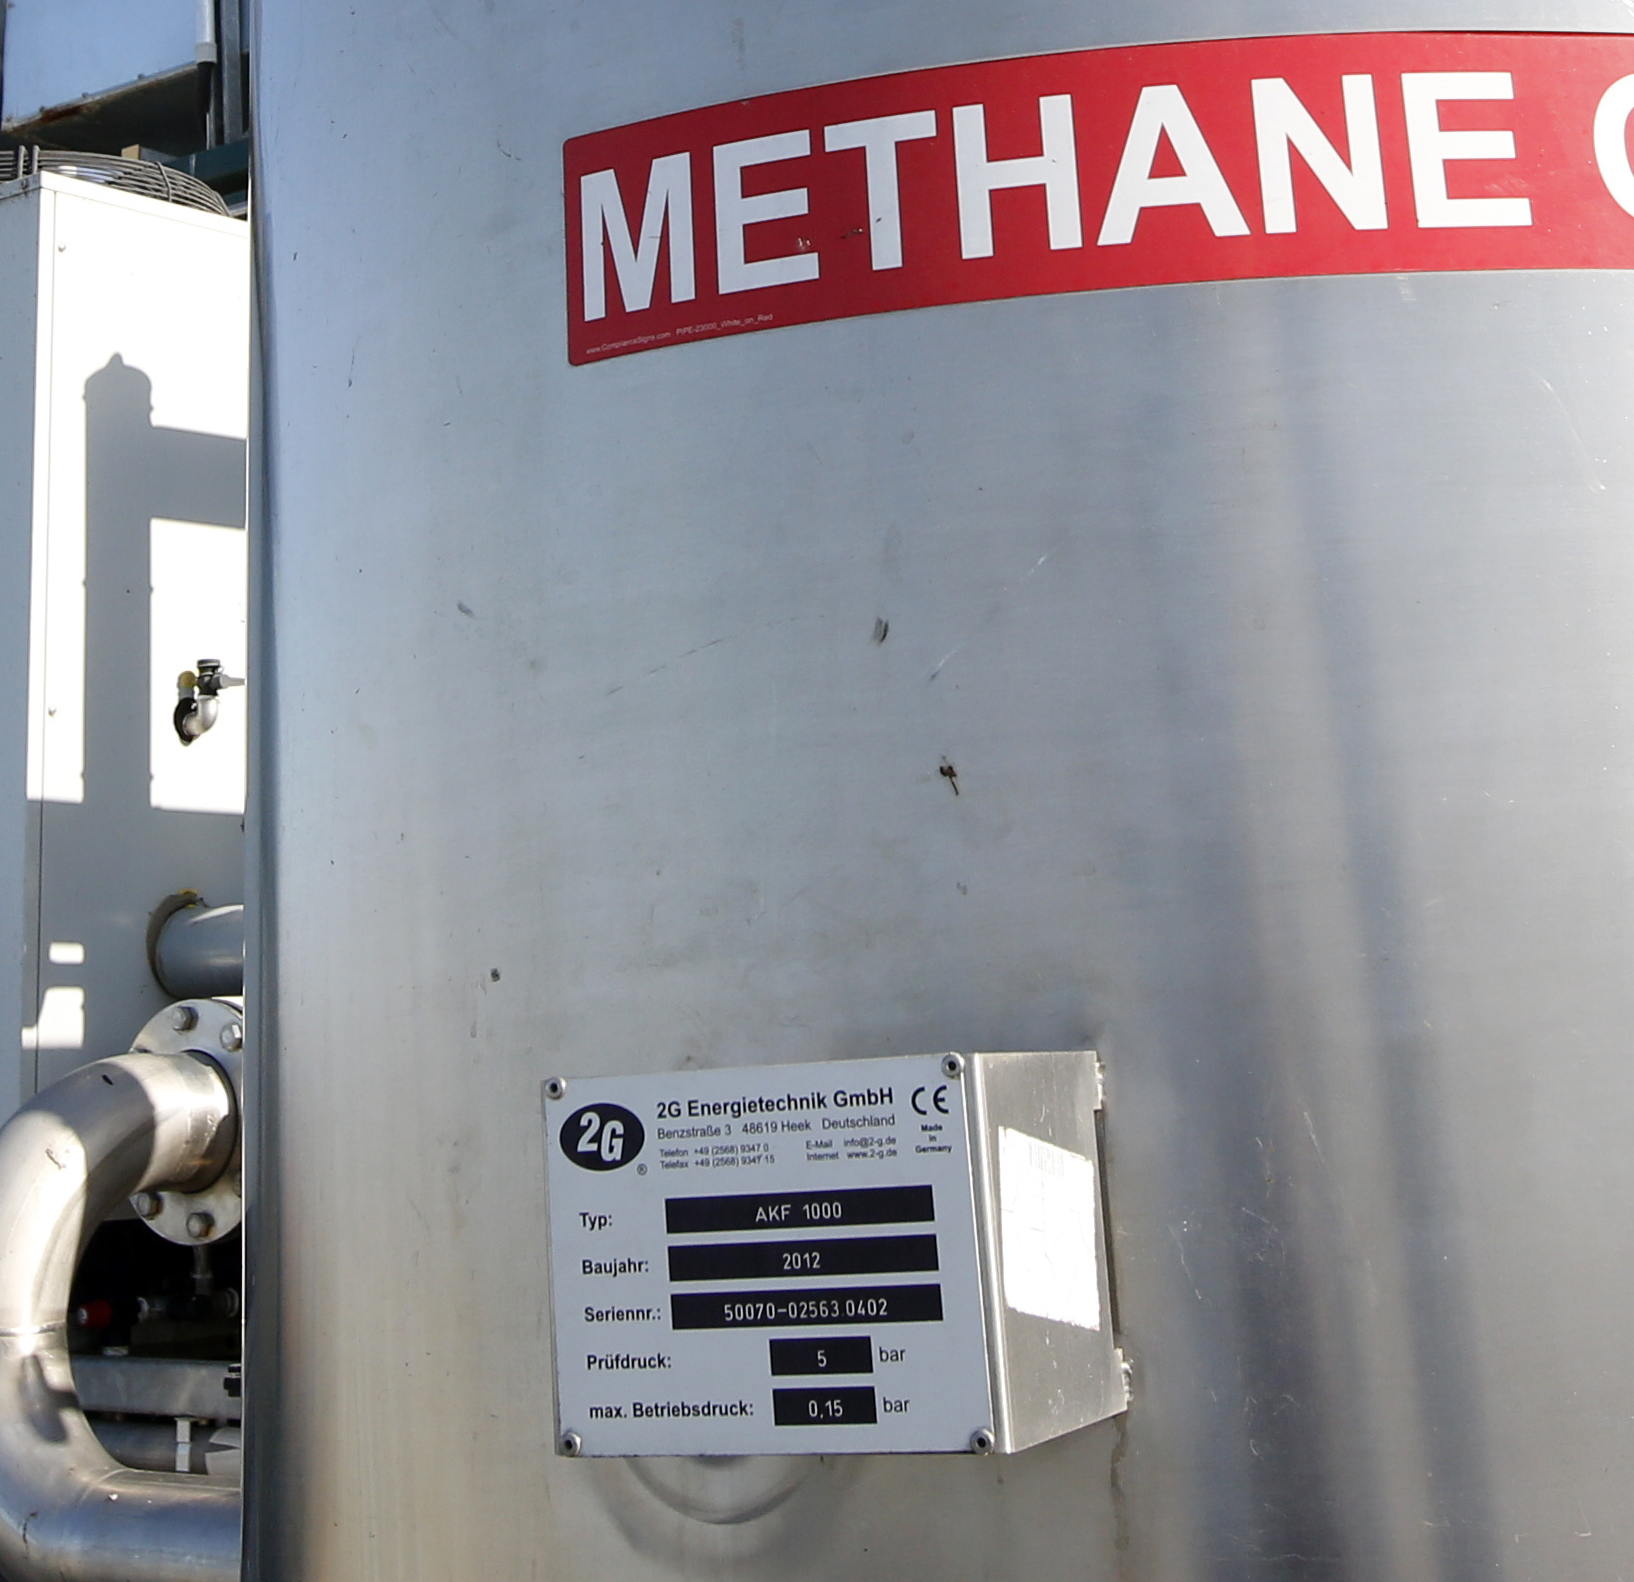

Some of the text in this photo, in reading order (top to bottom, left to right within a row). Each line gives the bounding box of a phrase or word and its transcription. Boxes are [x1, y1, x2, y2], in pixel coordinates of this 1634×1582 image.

[580, 71, 1533, 322] METHANE
[657, 1086, 894, 1119] 2G Energietechnik GmbH
[576, 1110, 625, 1162] 2G
[657, 1113, 896, 1140] Benzstraße 3 48619 Heek Deutschland
[921, 1123, 943, 1132] Made
[660, 1143, 769, 1158] Telefon +49 (2568) 9347 0
[806, 1136, 897, 1149] E-Mail info@2-g.de
[915, 1144, 953, 1156] Germany
[660, 1159, 689, 1170] Telefax
[695, 1158, 710, 1168] +49
[712, 1156, 739, 1168] (2568)
[807, 1149, 898, 1161] Internet www.2-g.de
[579, 1201, 842, 1231] Typ: AKF 1000
[582, 1251, 821, 1278] Baujahr: 2012
[584, 1306, 661, 1322] Seriennr.:
[586, 1346, 906, 1370] Prüfdruck: 5 bar
[589, 1396, 911, 1419] max. Betriebsdruck: 0,15 bar
